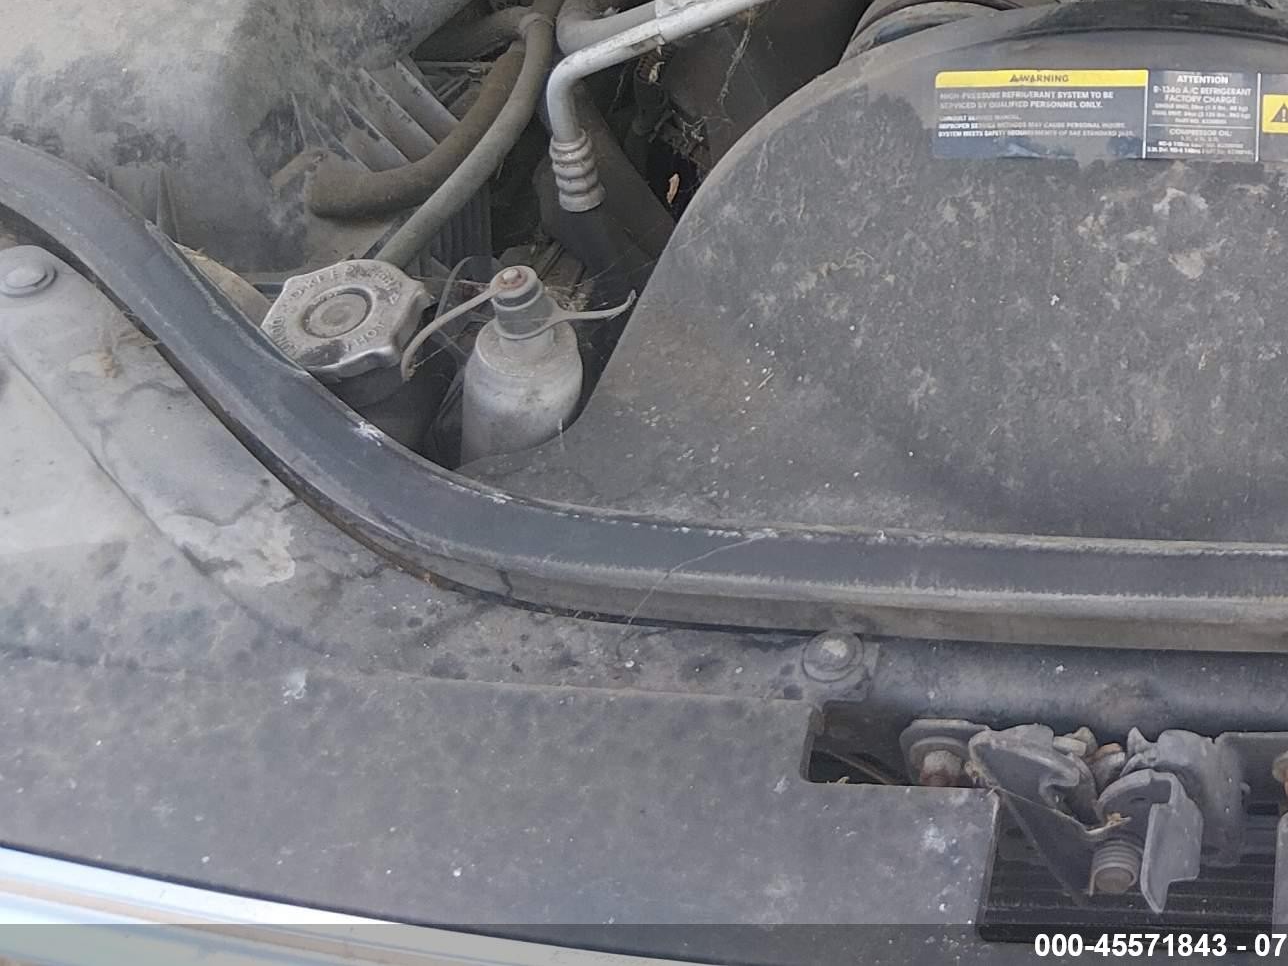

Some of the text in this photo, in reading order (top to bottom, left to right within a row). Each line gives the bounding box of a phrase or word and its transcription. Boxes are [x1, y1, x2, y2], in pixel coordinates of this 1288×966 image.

[1017, 74, 1069, 83] WARNING
[1177, 75, 1229, 84] ATTENTION
[1057, 91, 1089, 99] SYSTEM
[1091, 91, 1102, 99] TO
[1103, 91, 1114, 99] BE
[1200, 87, 1252, 96] REFRIGERANT
[1030, 100, 1078, 109] PERSONNEL
